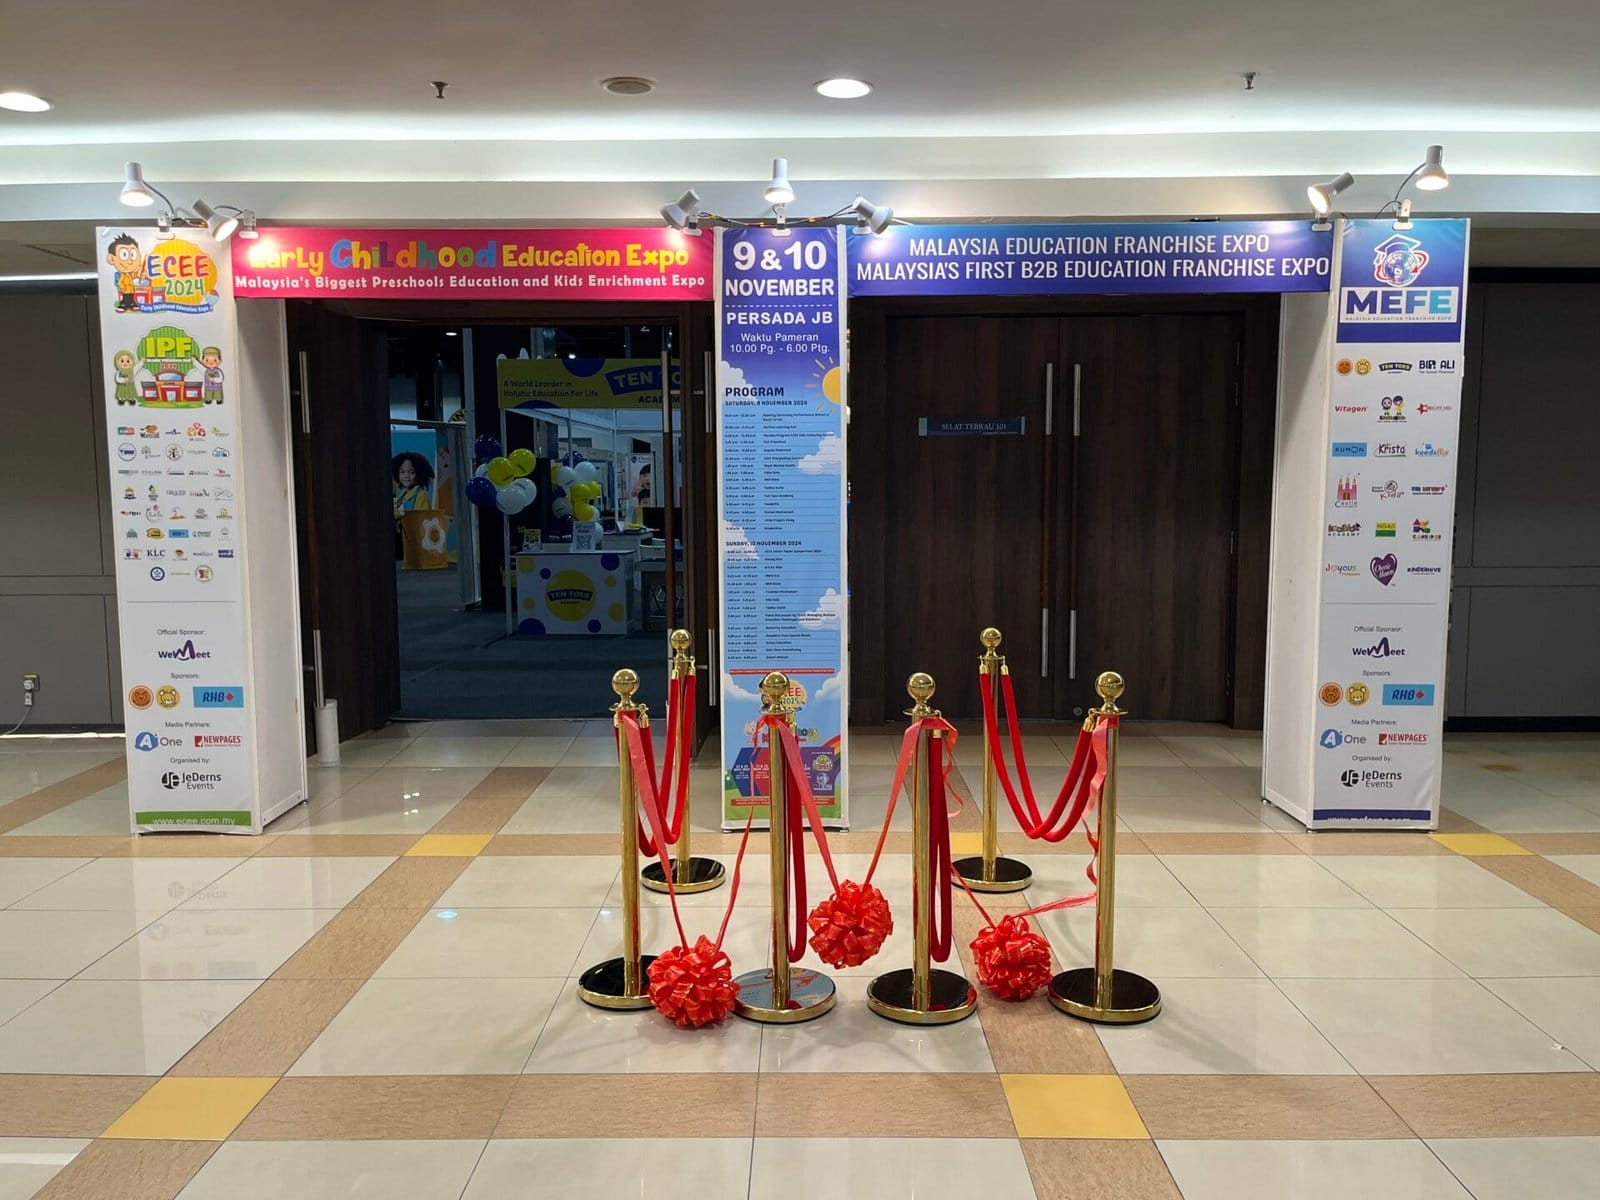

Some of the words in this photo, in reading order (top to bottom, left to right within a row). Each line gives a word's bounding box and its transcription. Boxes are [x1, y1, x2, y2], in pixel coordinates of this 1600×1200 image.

[910, 238, 999, 256] MALAYSIA
[1006, 236, 1107, 255] EDUCATION
[1114, 235, 1216, 254] FRANCHISE
[1223, 234, 1269, 253] EXPO
[502, 243, 620, 268] Education
[626, 244, 689, 273] Expo
[733, 242, 756, 270] 9
[761, 249, 782, 270] &
[784, 241, 827, 270] 10
[147, 255, 209, 278] ECEE
[857, 261, 959, 280] MALAYSIA'S
[966, 261, 1015, 279] FIRST
[1021, 261, 1057, 278] B2B
[1064, 260, 1165, 278] EDUCATION
[1173, 259, 1275, 277] FRANCHISE
[1282, 258, 1329, 276] EXPO
[164, 278, 204, 296] 2024
[235, 276, 310, 290] Malaysia's
[315, 276, 367, 290] Biggest
[372, 276, 444, 288] Preschools
[450, 276, 519, 288] Education
[523, 275, 549, 287] and
[554, 275, 583, 287] Kids
[588, 275, 667, 287] Enrichment
[672, 275, 705, 289] Expo
[725, 278, 834, 296] NOVEMBER
[1346, 290, 1452, 314] MEFE
[727, 312, 806, 324] PERSADA
[812, 311, 832, 324] JB
[741, 333, 771, 342] Waktu
[775, 333, 818, 341] Pameran
[146, 338, 192, 358] IPF
[760, 344, 776, 354] Pg.
[786, 344, 807, 352] 6.00
[614, 373, 653, 388] TEN
[725, 387, 784, 396] PROGRAM
[1379, 444, 1405, 454] Krista
[203, 692, 225, 702] RHB
[1392, 689, 1415, 700] RHB
[160, 737, 183, 746] One
[1344, 734, 1367, 744] One
[182, 773, 221, 783] JeDerns
[1362, 771, 1402, 781] JeDerns
